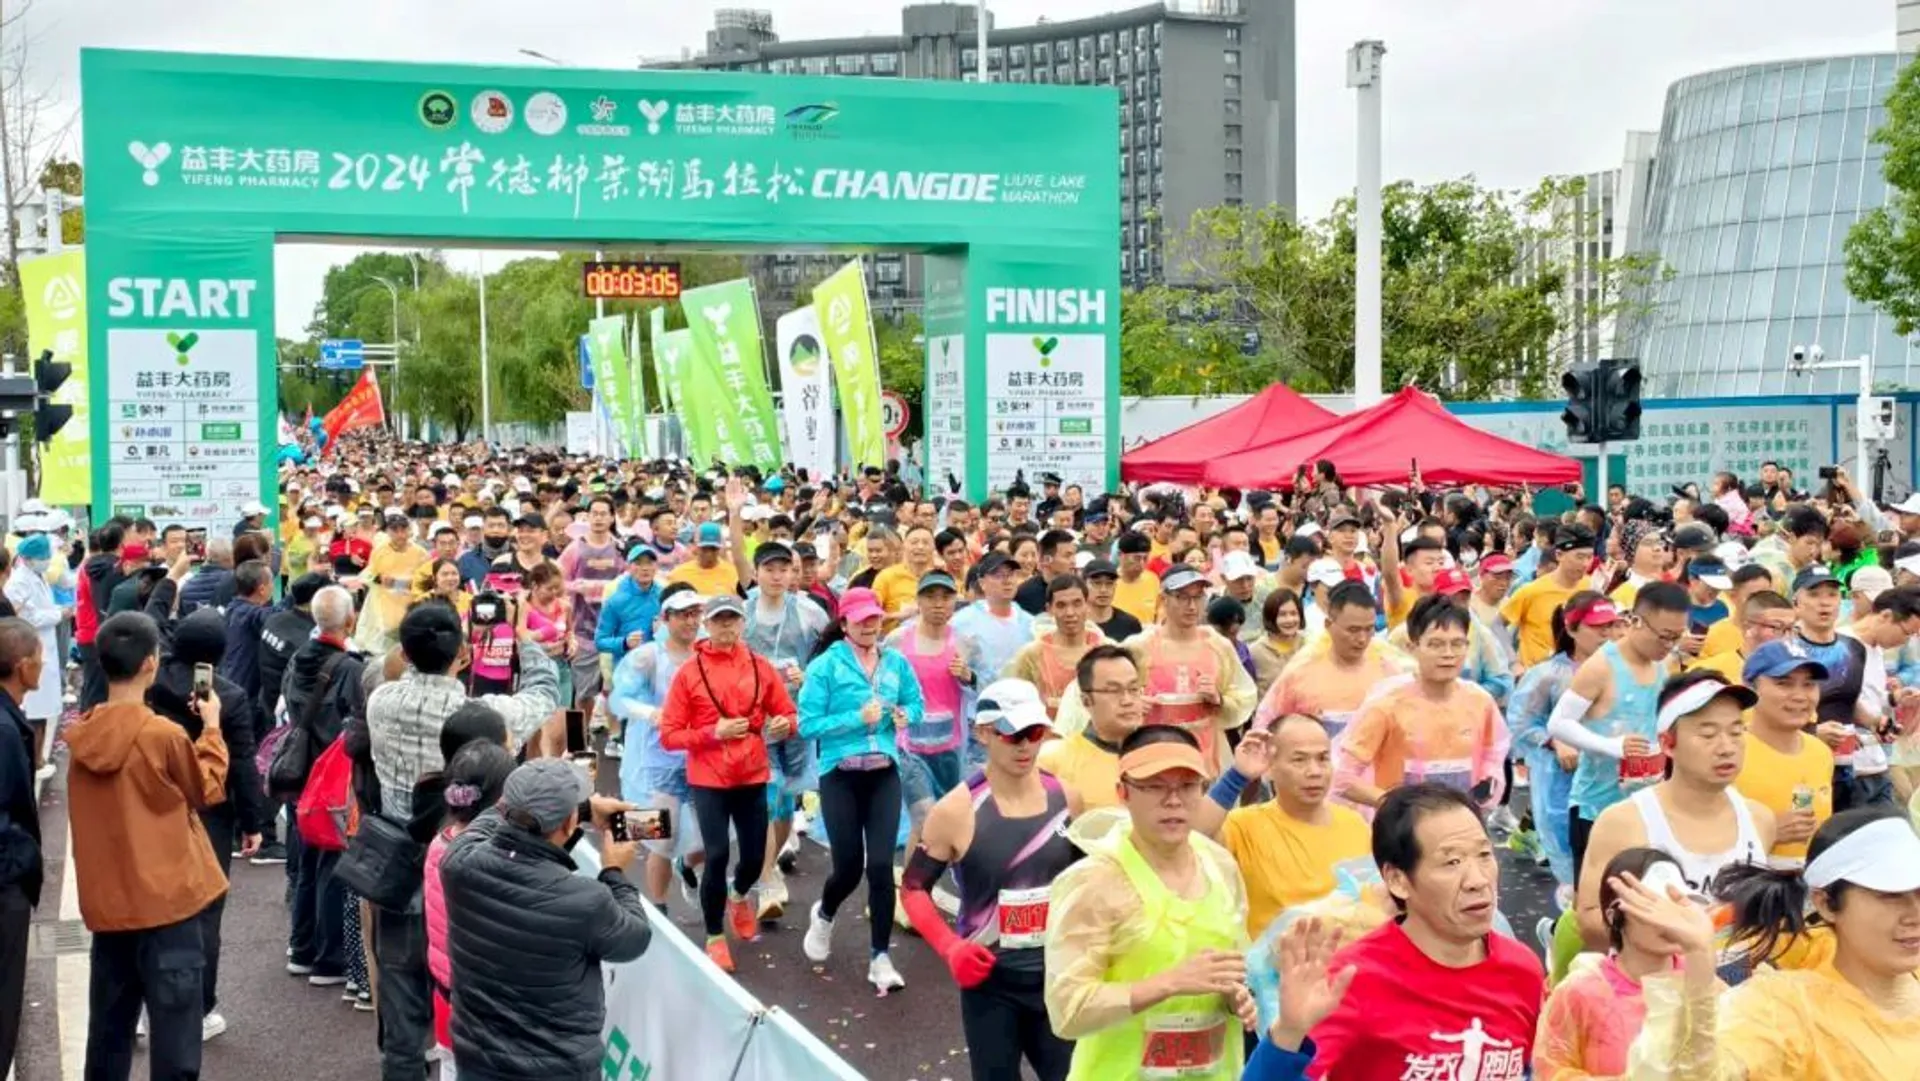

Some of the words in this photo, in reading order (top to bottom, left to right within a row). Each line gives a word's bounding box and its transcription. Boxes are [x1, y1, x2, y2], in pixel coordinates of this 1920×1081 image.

[675, 103, 776, 124] 益丰大药房
[676, 124, 713, 134] YIFENG
[716, 125, 775, 136] PHARMACY
[181, 146, 320, 173] 益丰大药房
[181, 174, 233, 186] YIFENG
[239, 174, 320, 188] PHARMACY
[328, 152, 430, 192] 2024
[1003, 172, 1043, 187] LIUYE
[1050, 173, 1087, 188] LAKE
[811, 168, 1000, 203] CHANGDE
[1002, 190, 1081, 204] MARATHON
[586, 272, 679, 296] 00:03:05
[108, 278, 256, 318] START
[985, 288, 1105, 324] FINISH
[136, 371, 231, 388] 益丰大药房
[1007, 371, 1084, 387] 益丰大药房
